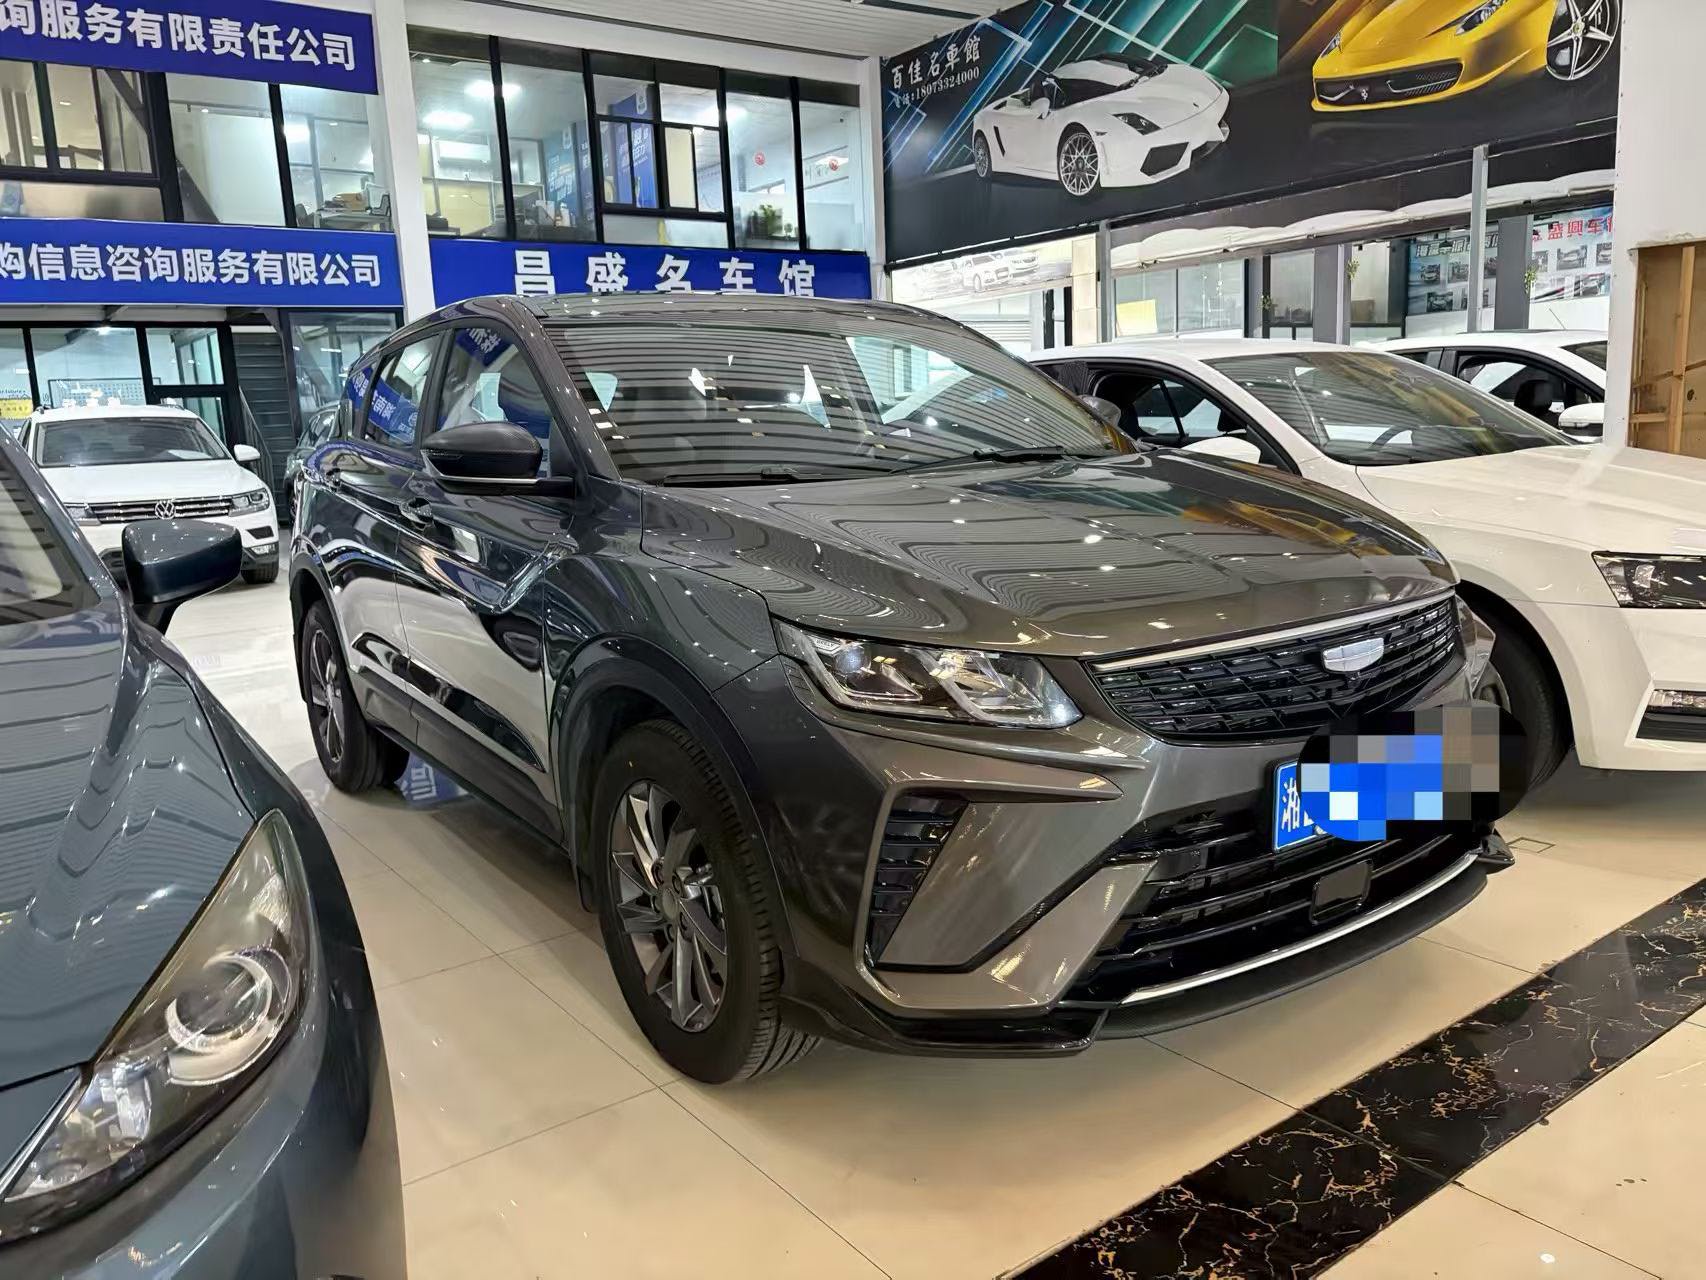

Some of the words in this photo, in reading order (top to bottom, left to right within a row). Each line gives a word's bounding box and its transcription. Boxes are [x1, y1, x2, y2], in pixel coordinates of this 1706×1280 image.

[0, 0, 356, 72] 询服务有限责任公司
[891, 34, 981, 89] 百佳名車館
[0, 241, 381, 288] 购信息咨询服务有限公司
[514, 249, 816, 297] 昌盛名车馆
